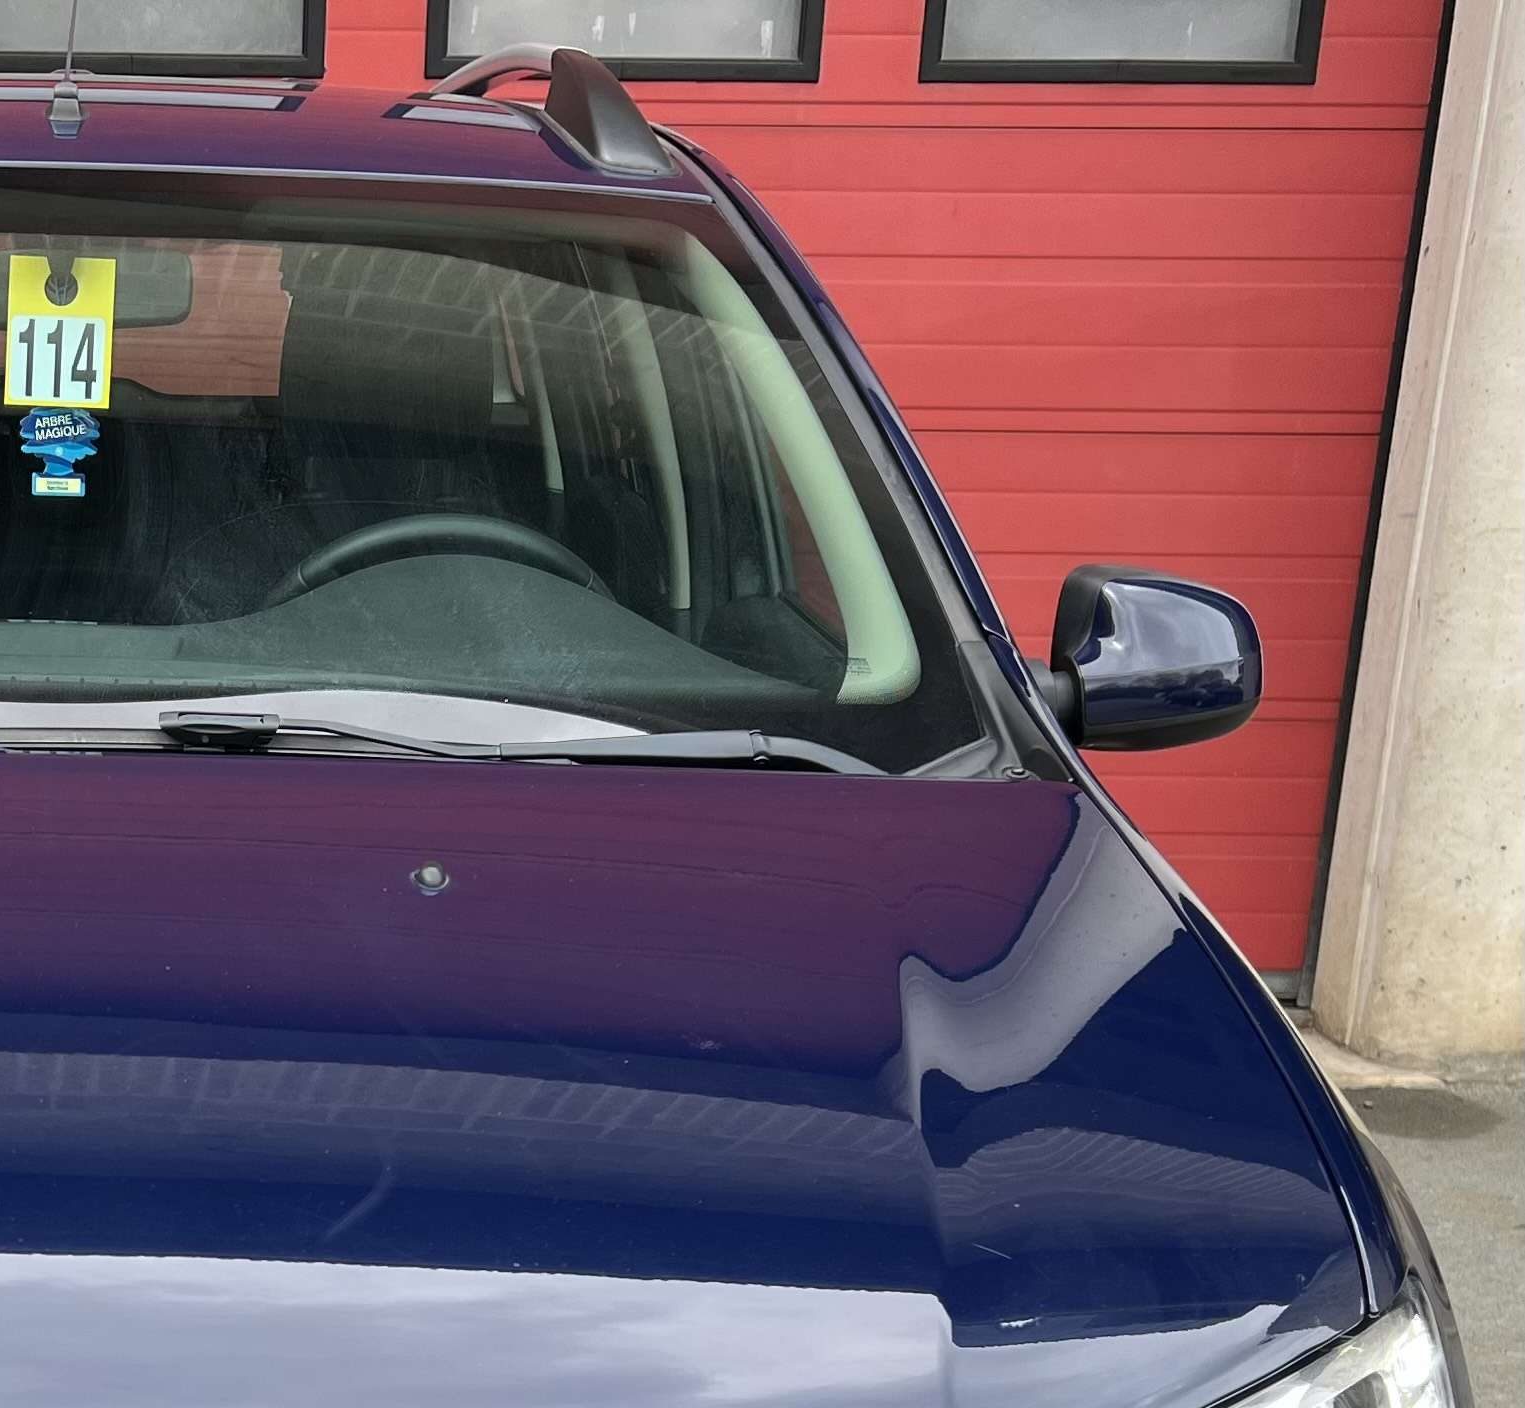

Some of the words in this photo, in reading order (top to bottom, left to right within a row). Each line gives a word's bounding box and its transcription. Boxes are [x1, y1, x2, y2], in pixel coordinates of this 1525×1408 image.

[18, 318, 97, 400] 114
[34, 413, 73, 429] ARBRE
[34, 423, 87, 441] MAGIQUE
